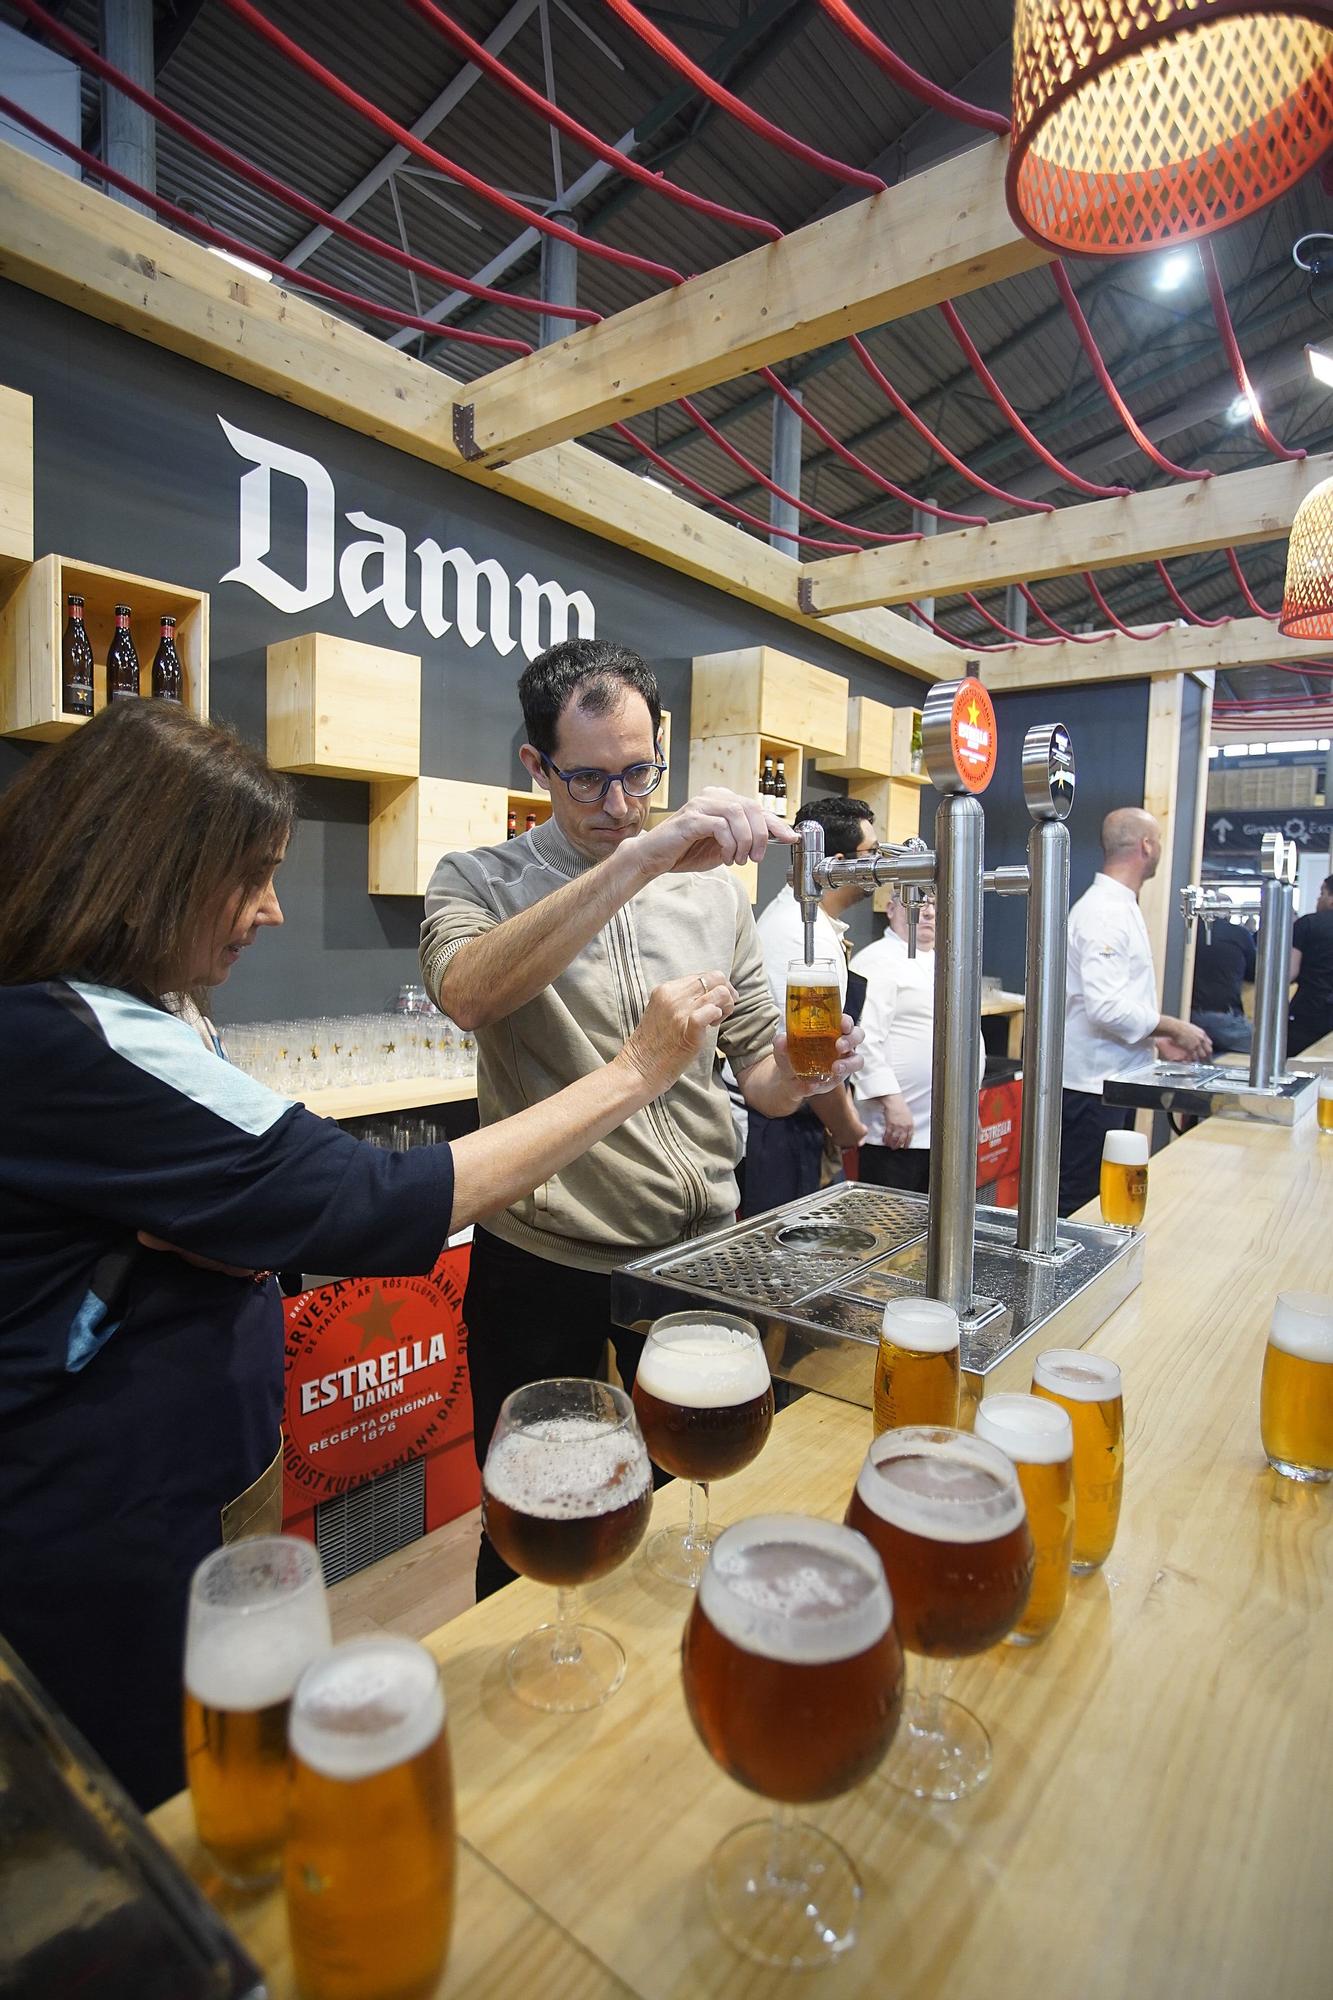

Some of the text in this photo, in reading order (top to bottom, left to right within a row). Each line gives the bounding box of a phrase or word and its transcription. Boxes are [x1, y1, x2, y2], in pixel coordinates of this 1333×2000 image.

[216, 413, 596, 662] Damm
[302, 1332, 448, 1415] ESTRELLA
[353, 1378, 404, 1412] DAMM
[437, 1365, 466, 1421] DAMM
[309, 1418, 377, 1454] RECEPTA
[379, 1391, 443, 1424] ORIGINAL
[361, 1422, 397, 1443] 1876
